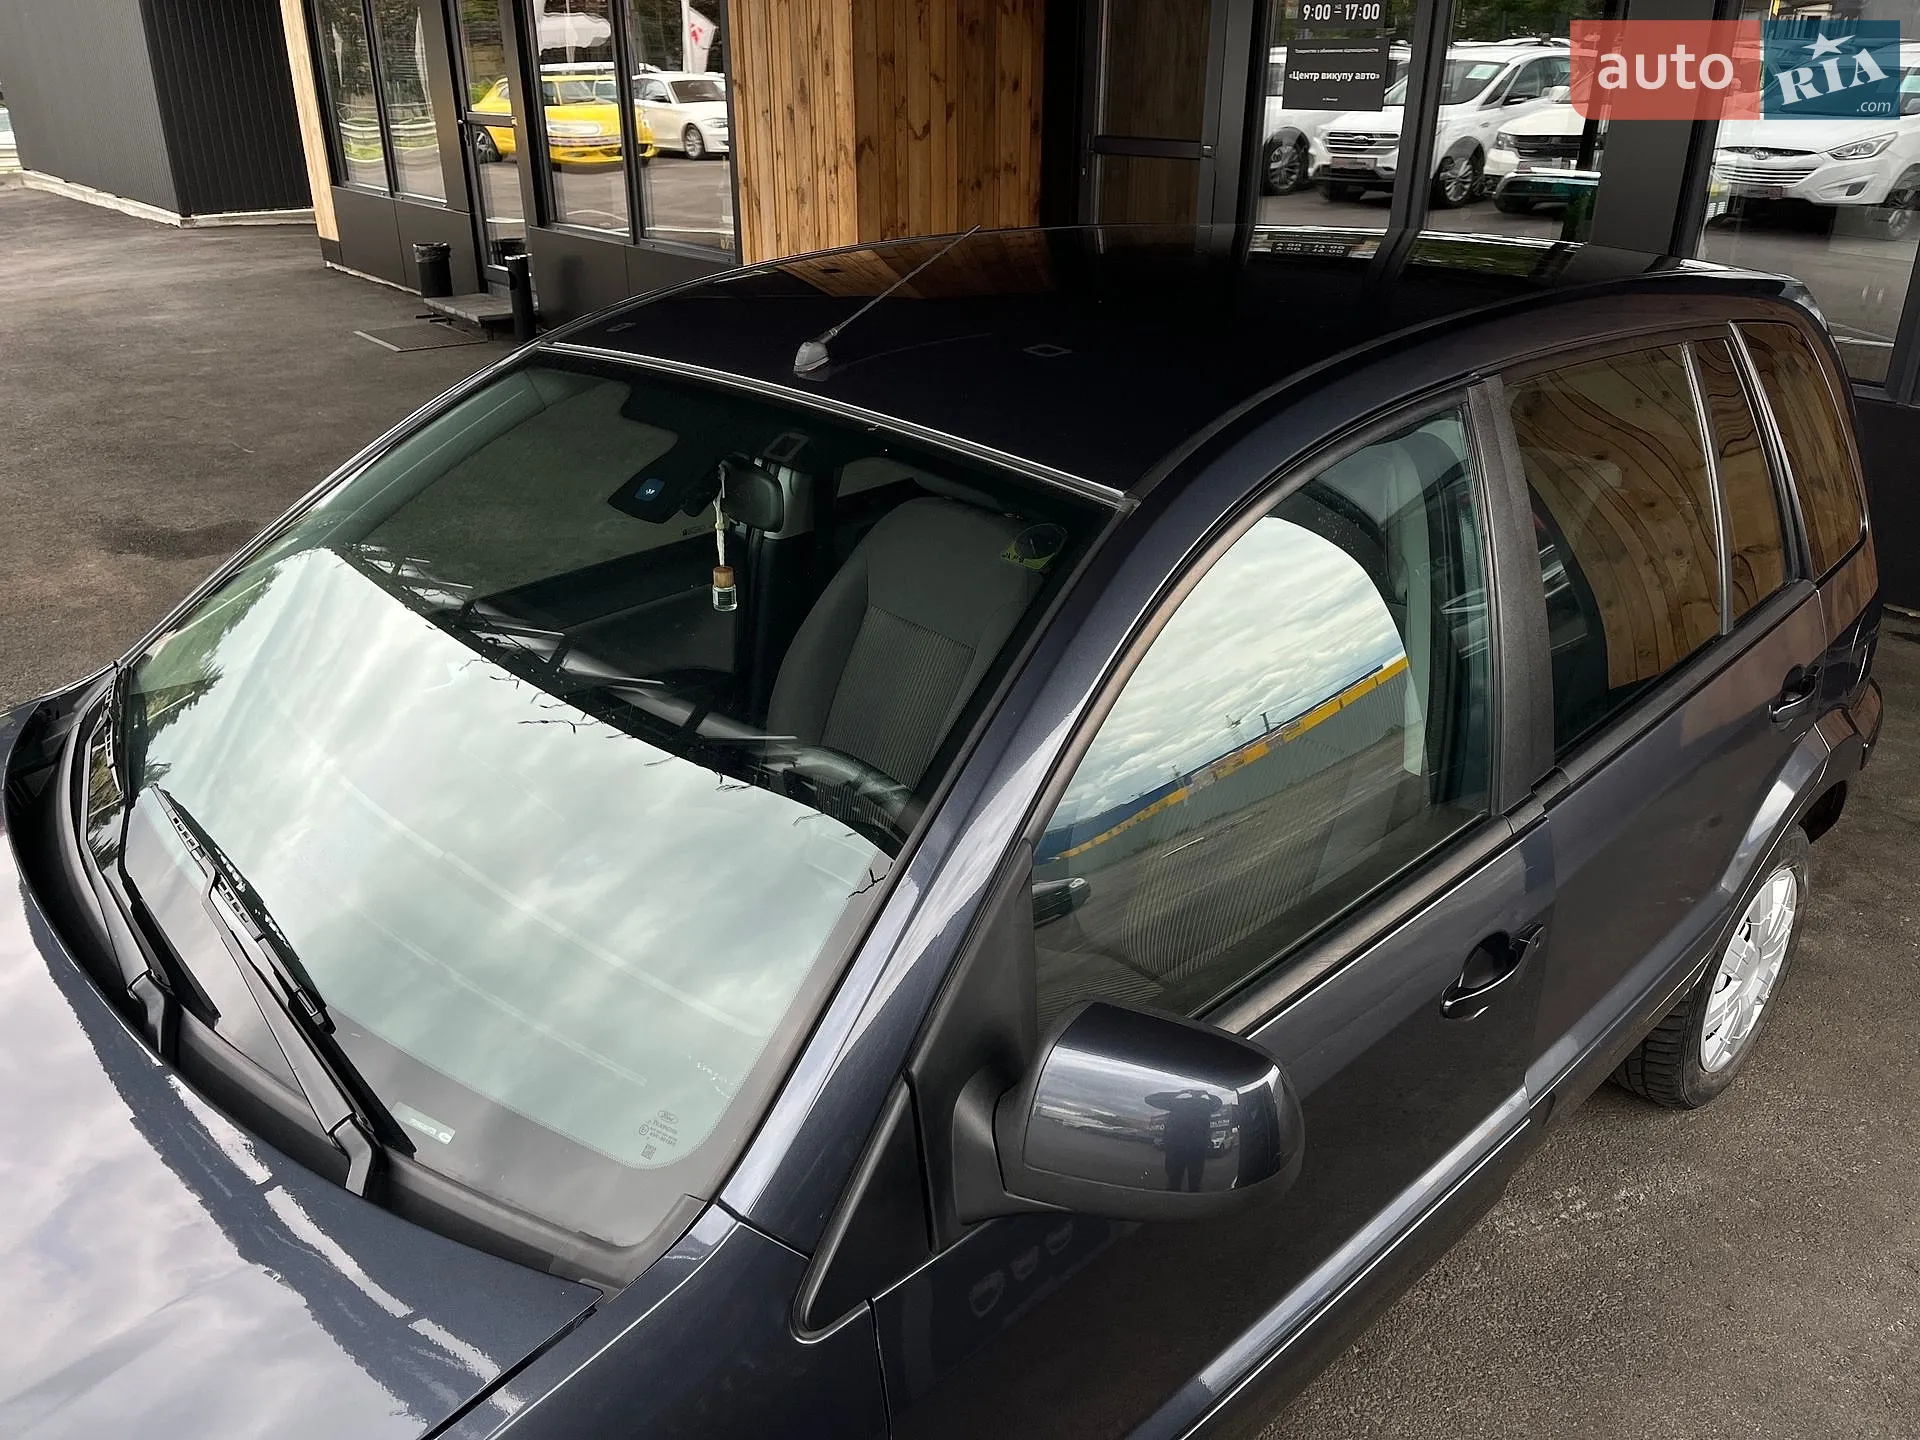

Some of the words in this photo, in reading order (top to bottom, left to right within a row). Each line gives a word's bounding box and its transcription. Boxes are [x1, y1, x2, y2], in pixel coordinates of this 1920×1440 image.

[1303, 3, 1332, 21] 9:00
[1345, 3, 1380, 20] 17:00
[1289, 70, 1320, 82] «Центр
[1321, 71, 1353, 82] викупу
[1354, 71, 1380, 80] авто»
